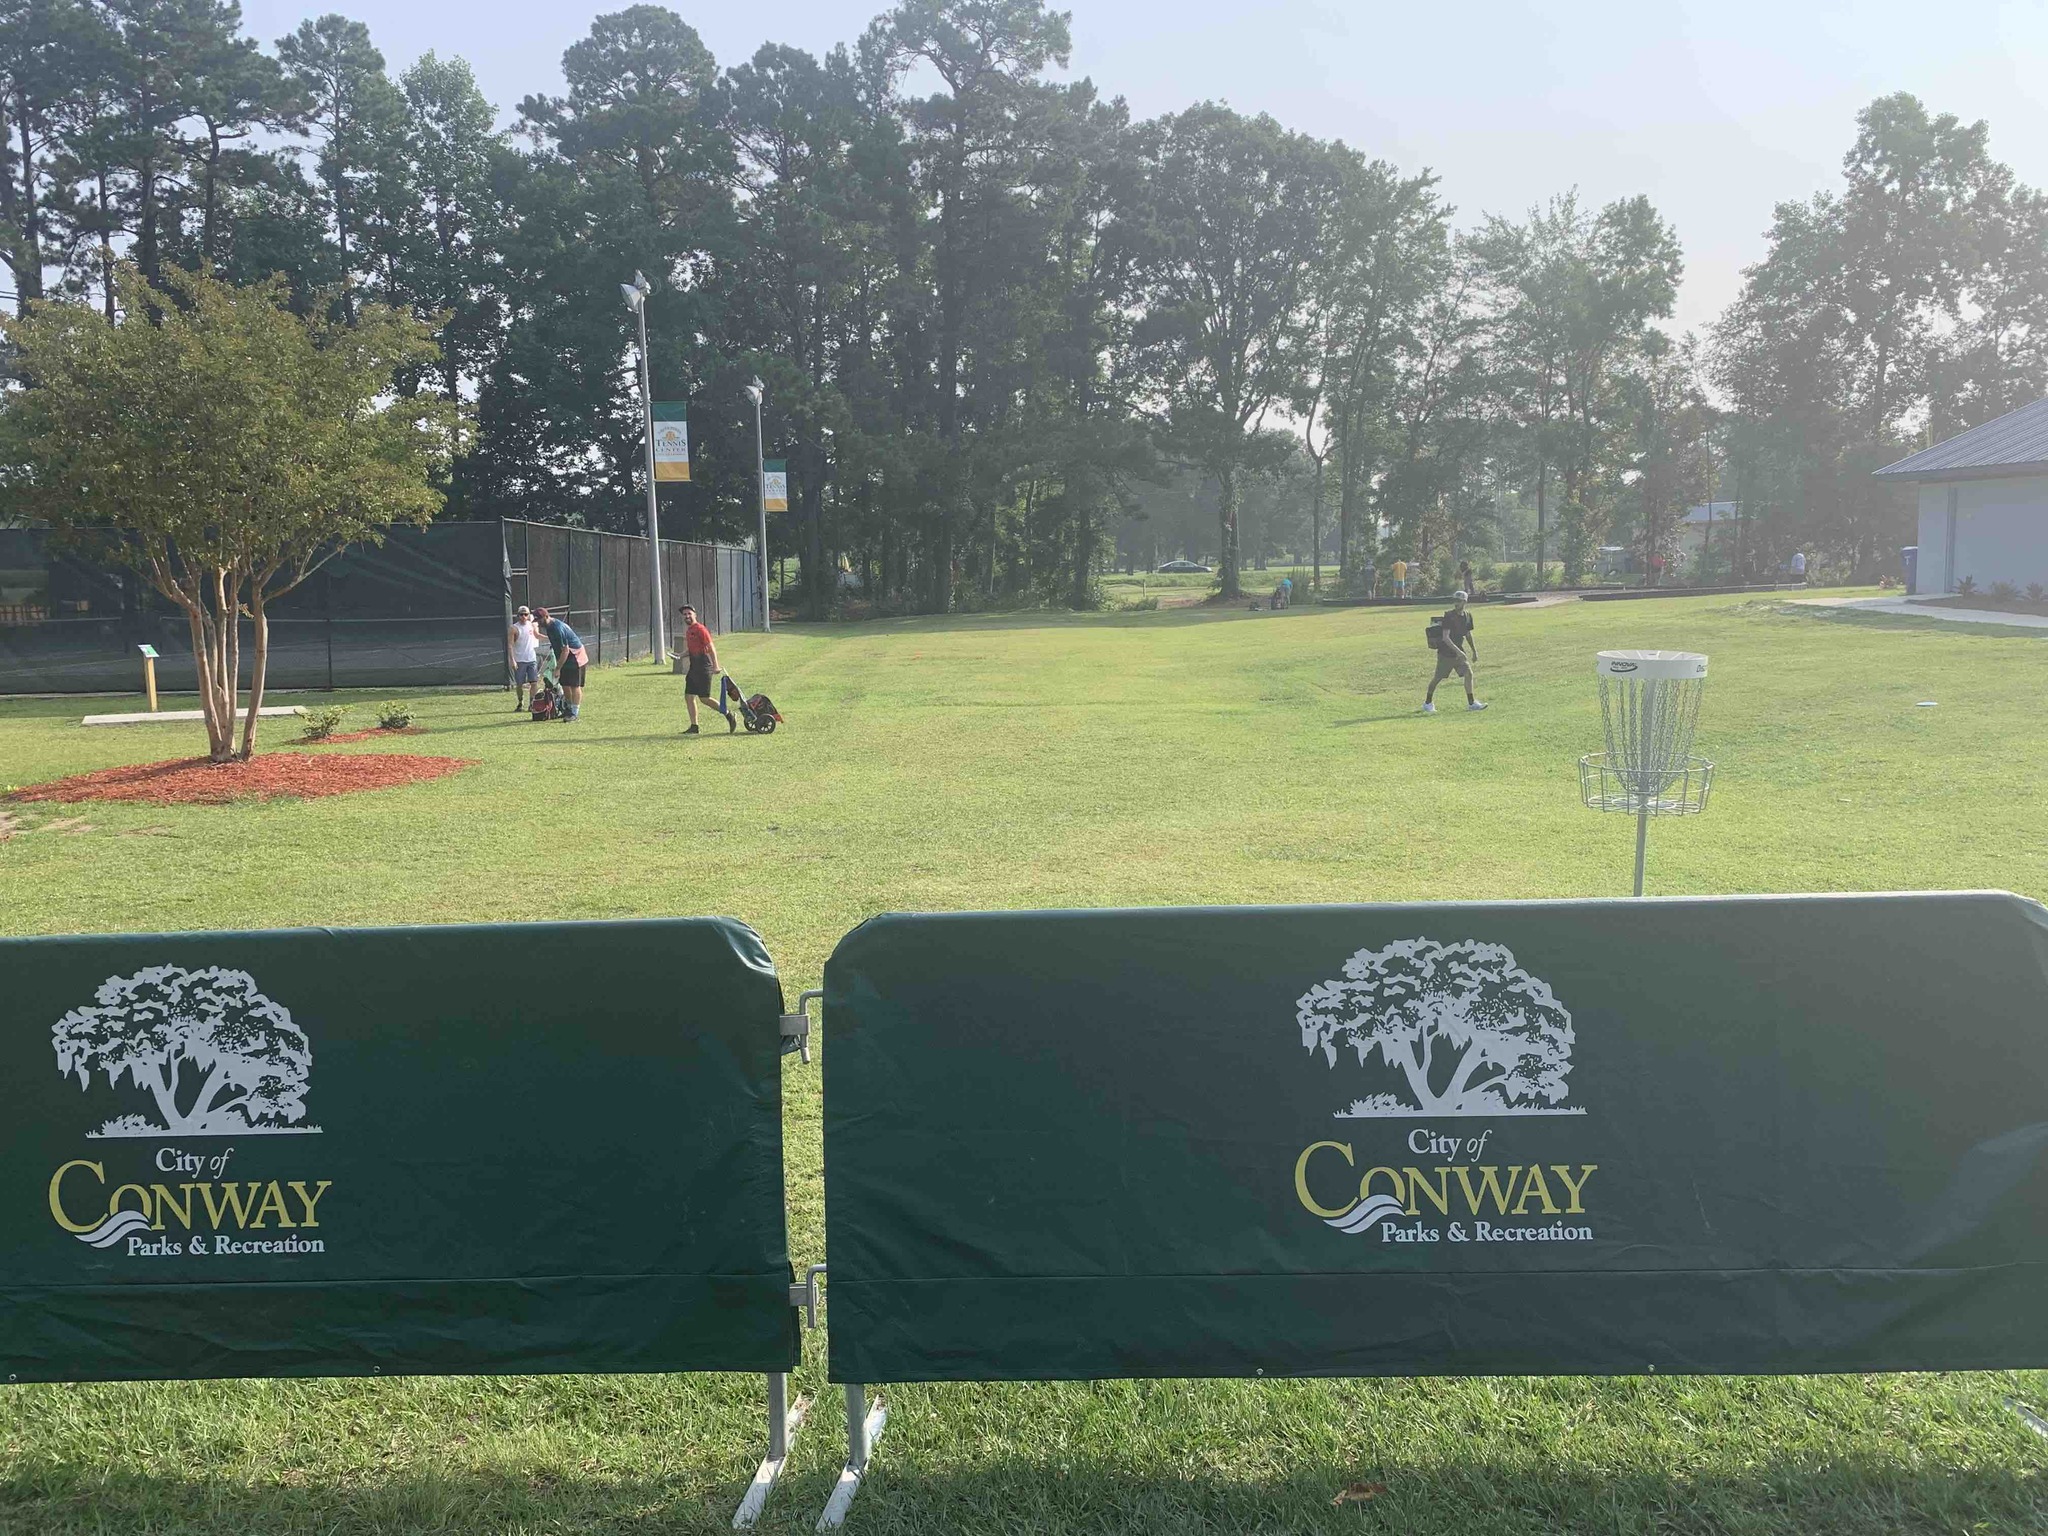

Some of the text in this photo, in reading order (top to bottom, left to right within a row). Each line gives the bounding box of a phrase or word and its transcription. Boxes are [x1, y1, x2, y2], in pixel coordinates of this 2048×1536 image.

[655, 439, 687, 447] TENNIS
[1407, 1128, 1493, 1162] City of
[155, 1147, 235, 1179] City of
[1294, 1140, 1599, 1218] CONWAY
[48, 1159, 333, 1233] CONWAY
[126, 1233, 326, 1257] Parks & Recreation
[1381, 1219, 1594, 1243] Parks & Recreation
